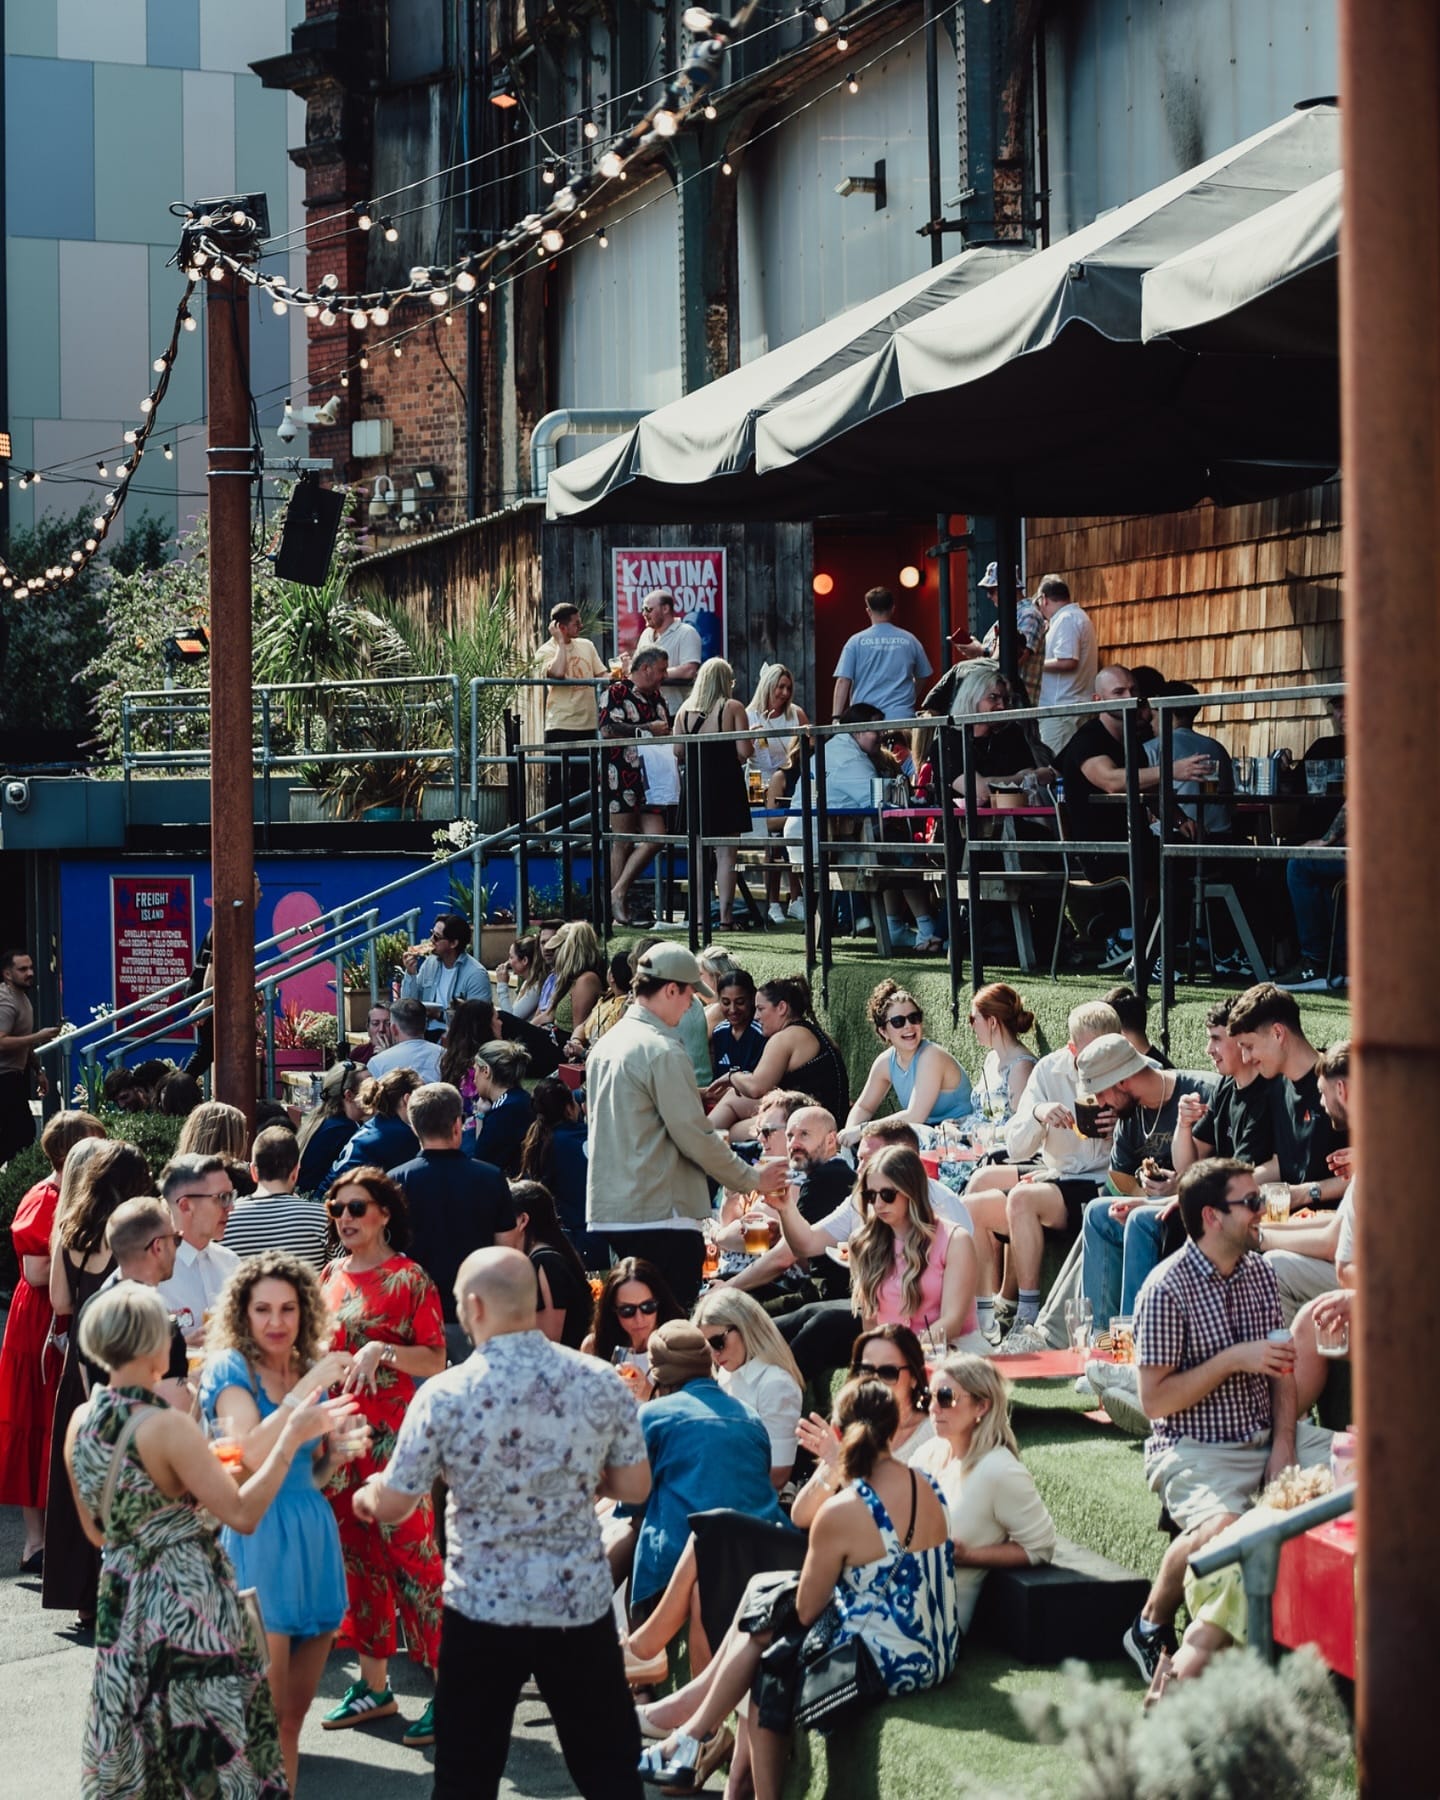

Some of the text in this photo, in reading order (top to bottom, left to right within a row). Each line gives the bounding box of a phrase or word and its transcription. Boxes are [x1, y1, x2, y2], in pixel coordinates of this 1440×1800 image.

[622, 559, 718, 586] KANTINA
[622, 586, 718, 613] THSDAY
[136, 892, 169, 908] FREIGHT
[141, 909, 164, 921] ISLAND
